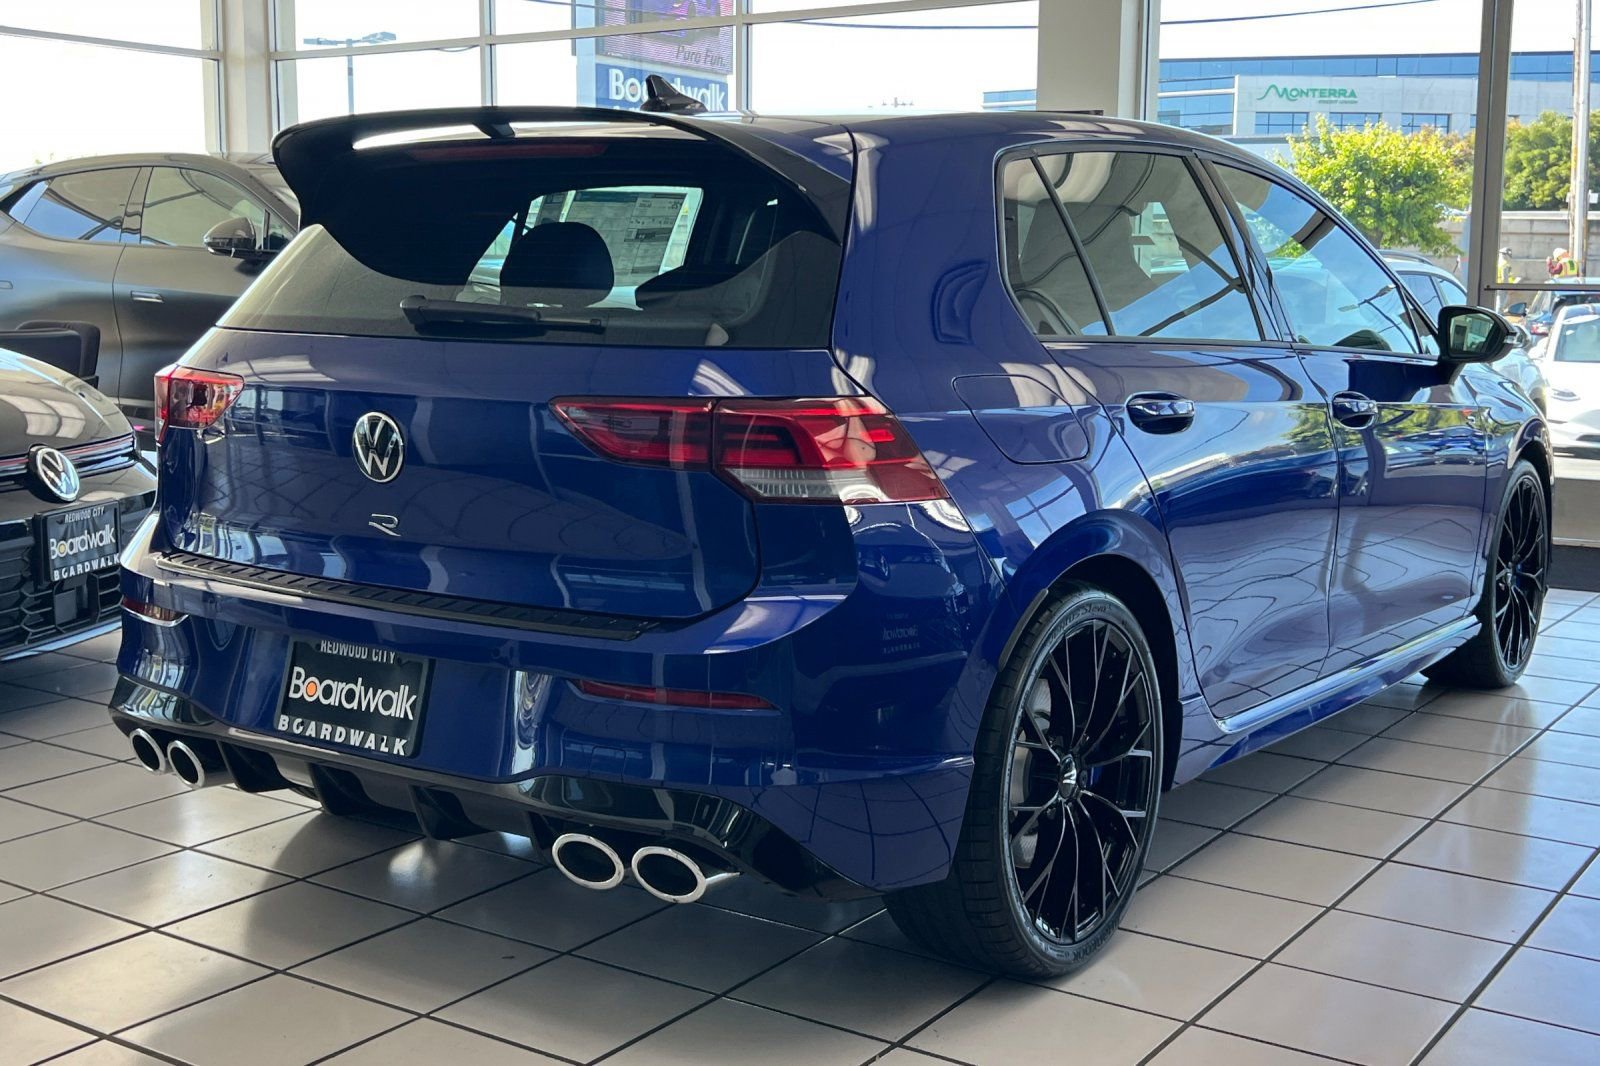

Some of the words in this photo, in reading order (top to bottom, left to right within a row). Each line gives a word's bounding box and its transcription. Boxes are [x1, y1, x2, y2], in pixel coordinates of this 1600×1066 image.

[676, 45, 700, 65] Pure
[608, 69, 725, 112] Bodwalk
[1256, 84, 1358, 101] MONTERRA
[64, 511, 92, 524] REDWOOD
[93, 505, 105, 519] CITY
[50, 524, 116, 560] Boardwalk
[53, 552, 121, 582] BOARDWALK
[320, 639, 368, 660] REDWOOD
[372, 648, 396, 665] CITY
[288, 665, 417, 721] Boardwalk
[277, 714, 408, 756] BOARDWALK
